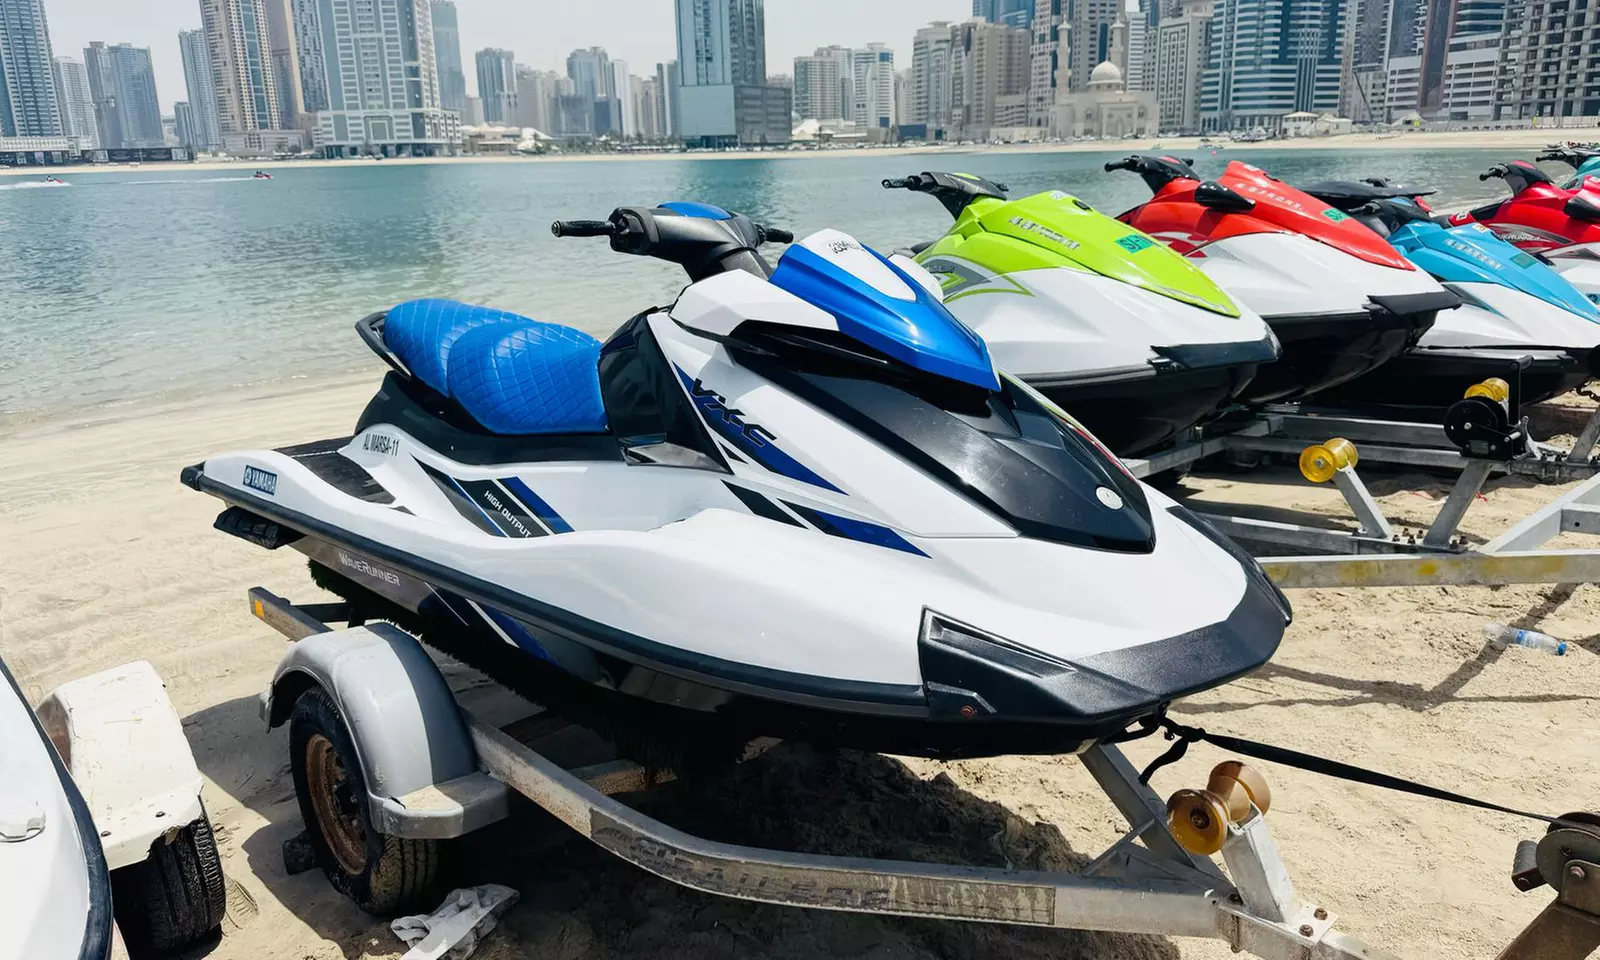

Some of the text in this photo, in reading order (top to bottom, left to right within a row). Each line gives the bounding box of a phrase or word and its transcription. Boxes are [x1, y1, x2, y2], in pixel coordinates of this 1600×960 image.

[370, 435, 400, 457] MARSA-11
[250, 468, 277, 493] YAMAHA
[484, 490, 532, 538] HIGH OUTPUT
